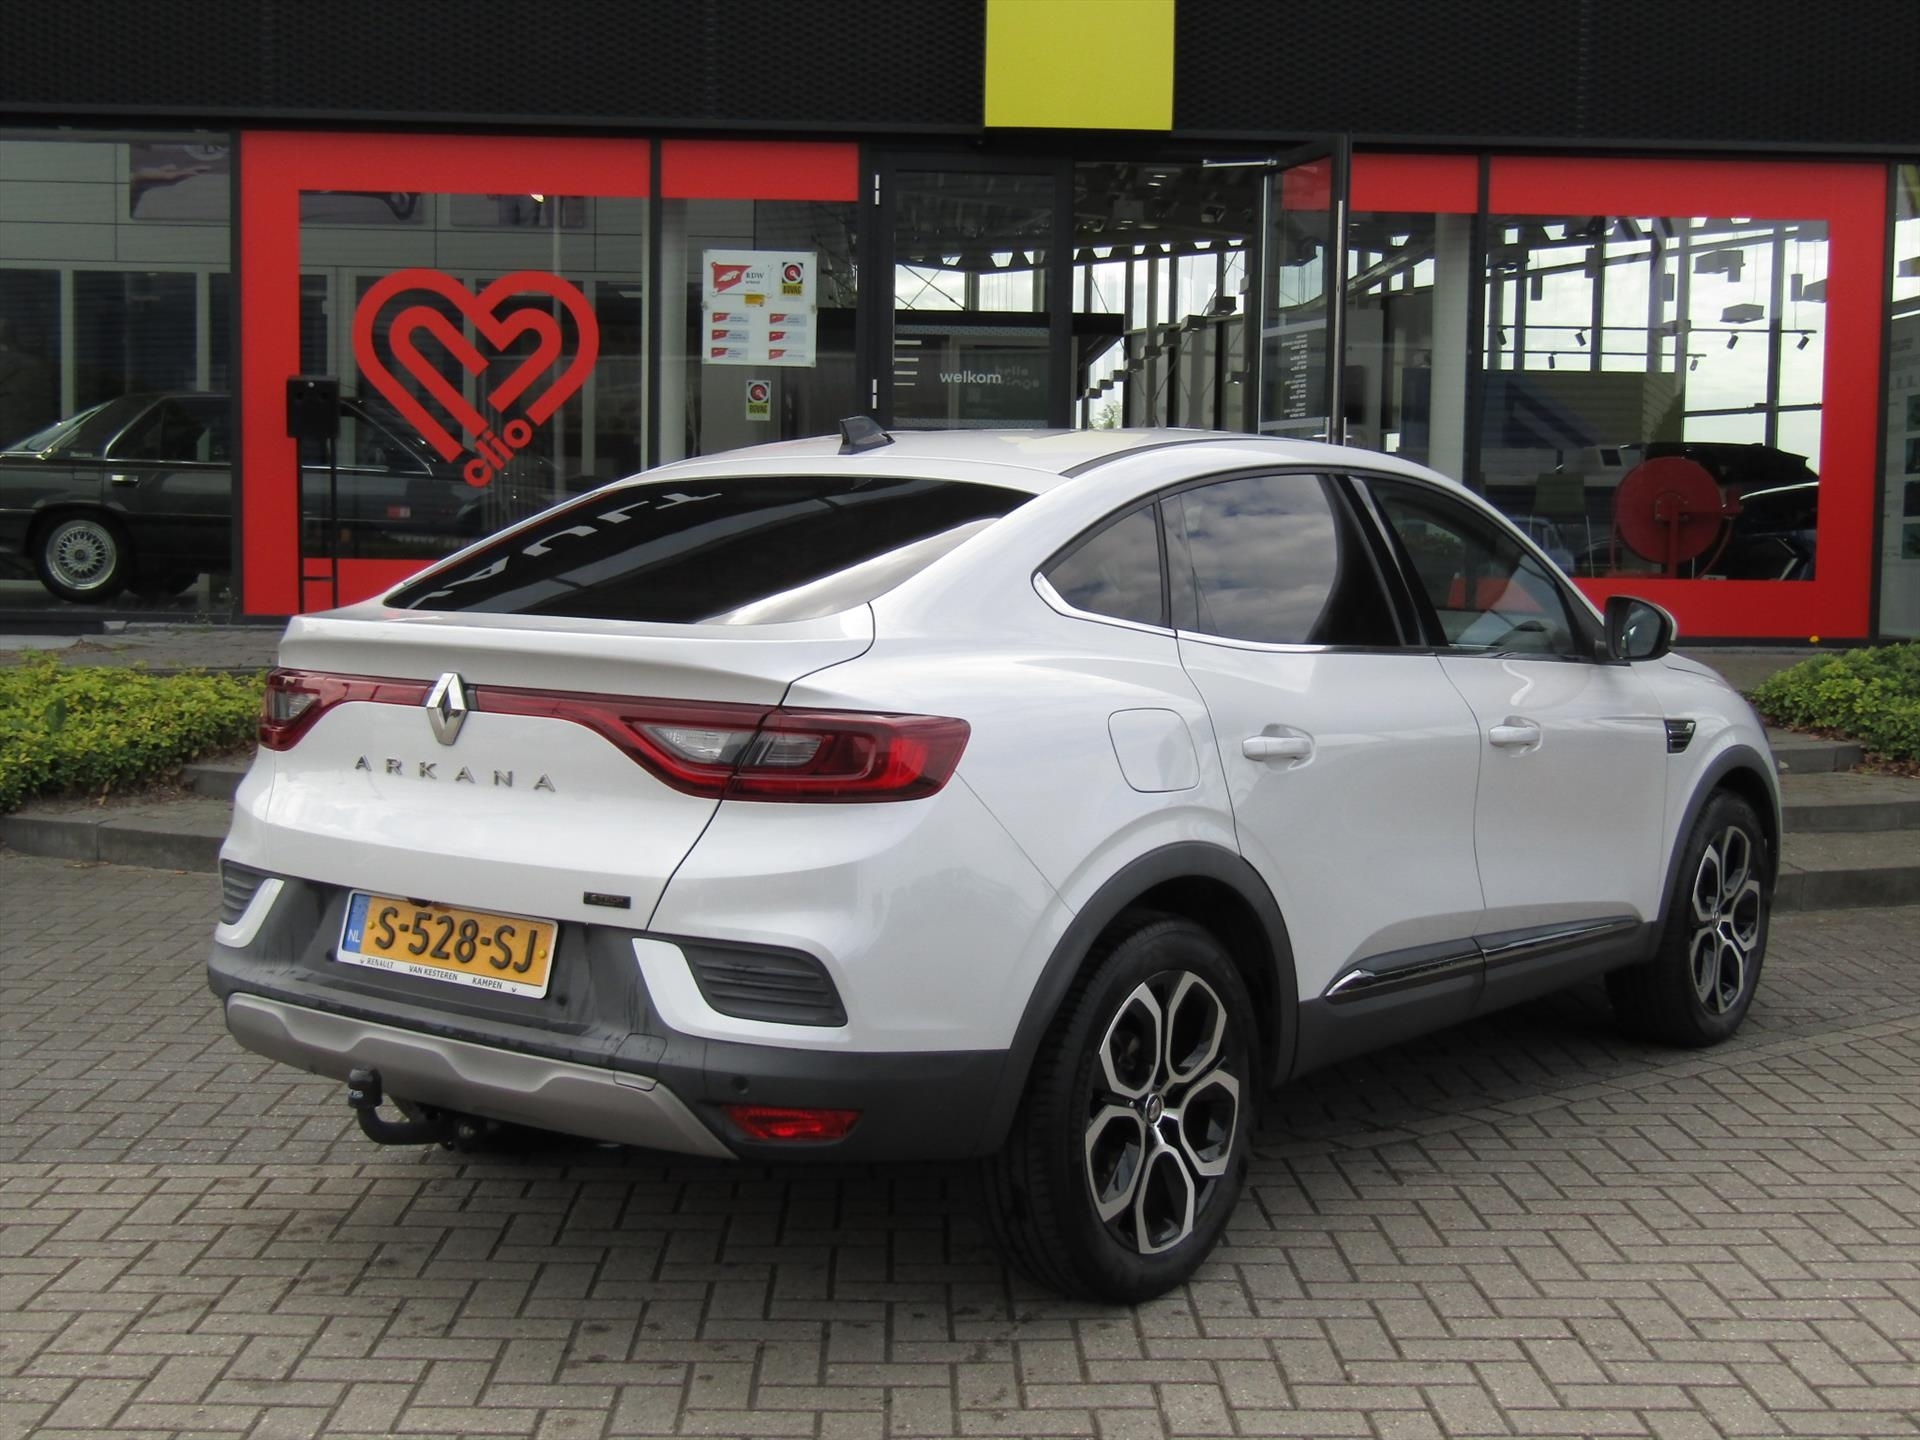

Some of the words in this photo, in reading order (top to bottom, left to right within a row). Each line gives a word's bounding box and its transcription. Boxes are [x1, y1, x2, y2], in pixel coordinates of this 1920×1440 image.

[939, 370, 1002, 384] welkom
[463, 418, 532, 488] clio
[355, 754, 556, 792] ARKANA
[347, 929, 360, 943] NL
[375, 906, 538, 973] S-528-SJ
[366, 957, 395, 969] RENAULT
[408, 964, 423, 975] VAN
[423, 967, 458, 981] KESTEREN
[472, 977, 503, 989] KAMPEN
